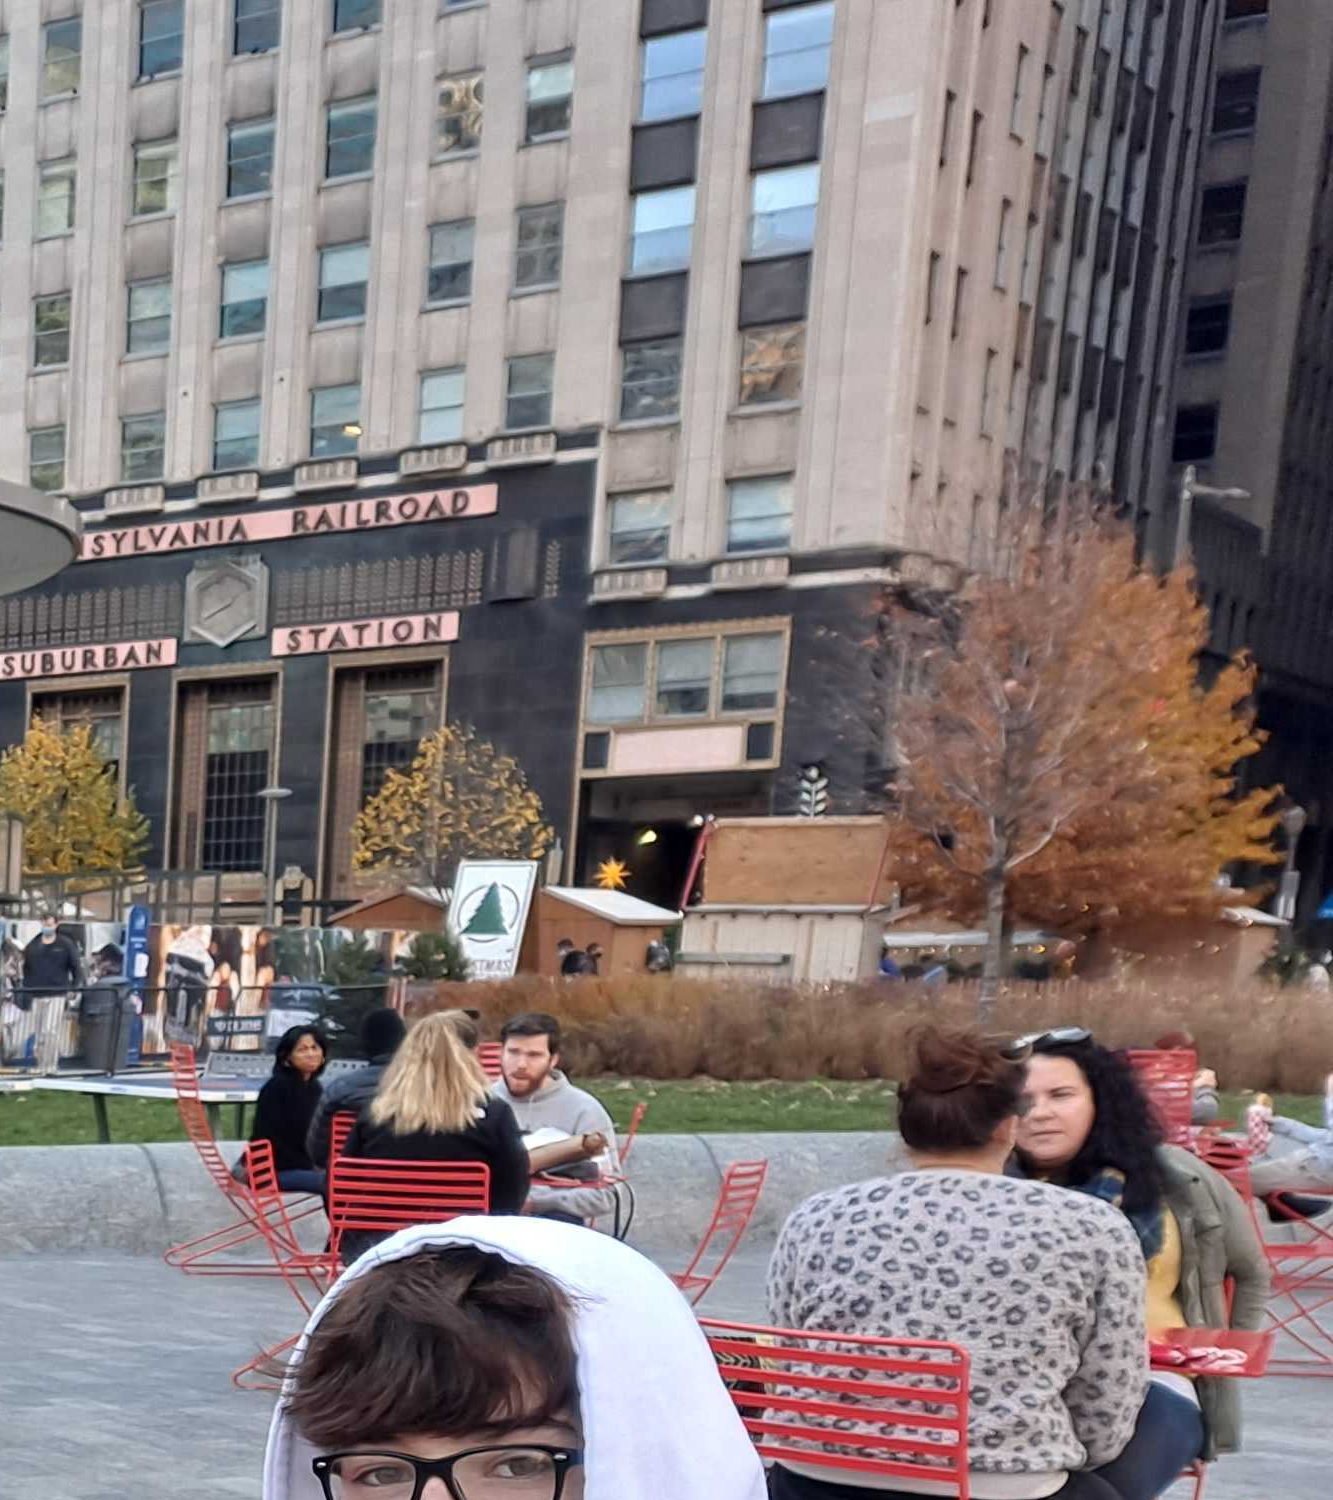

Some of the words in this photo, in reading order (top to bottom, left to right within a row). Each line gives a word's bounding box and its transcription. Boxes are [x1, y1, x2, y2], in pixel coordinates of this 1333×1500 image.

[292, 490, 471, 533] RAILROAD
[2, 641, 162, 677] SUBURBAN
[286, 614, 443, 653] STATION
